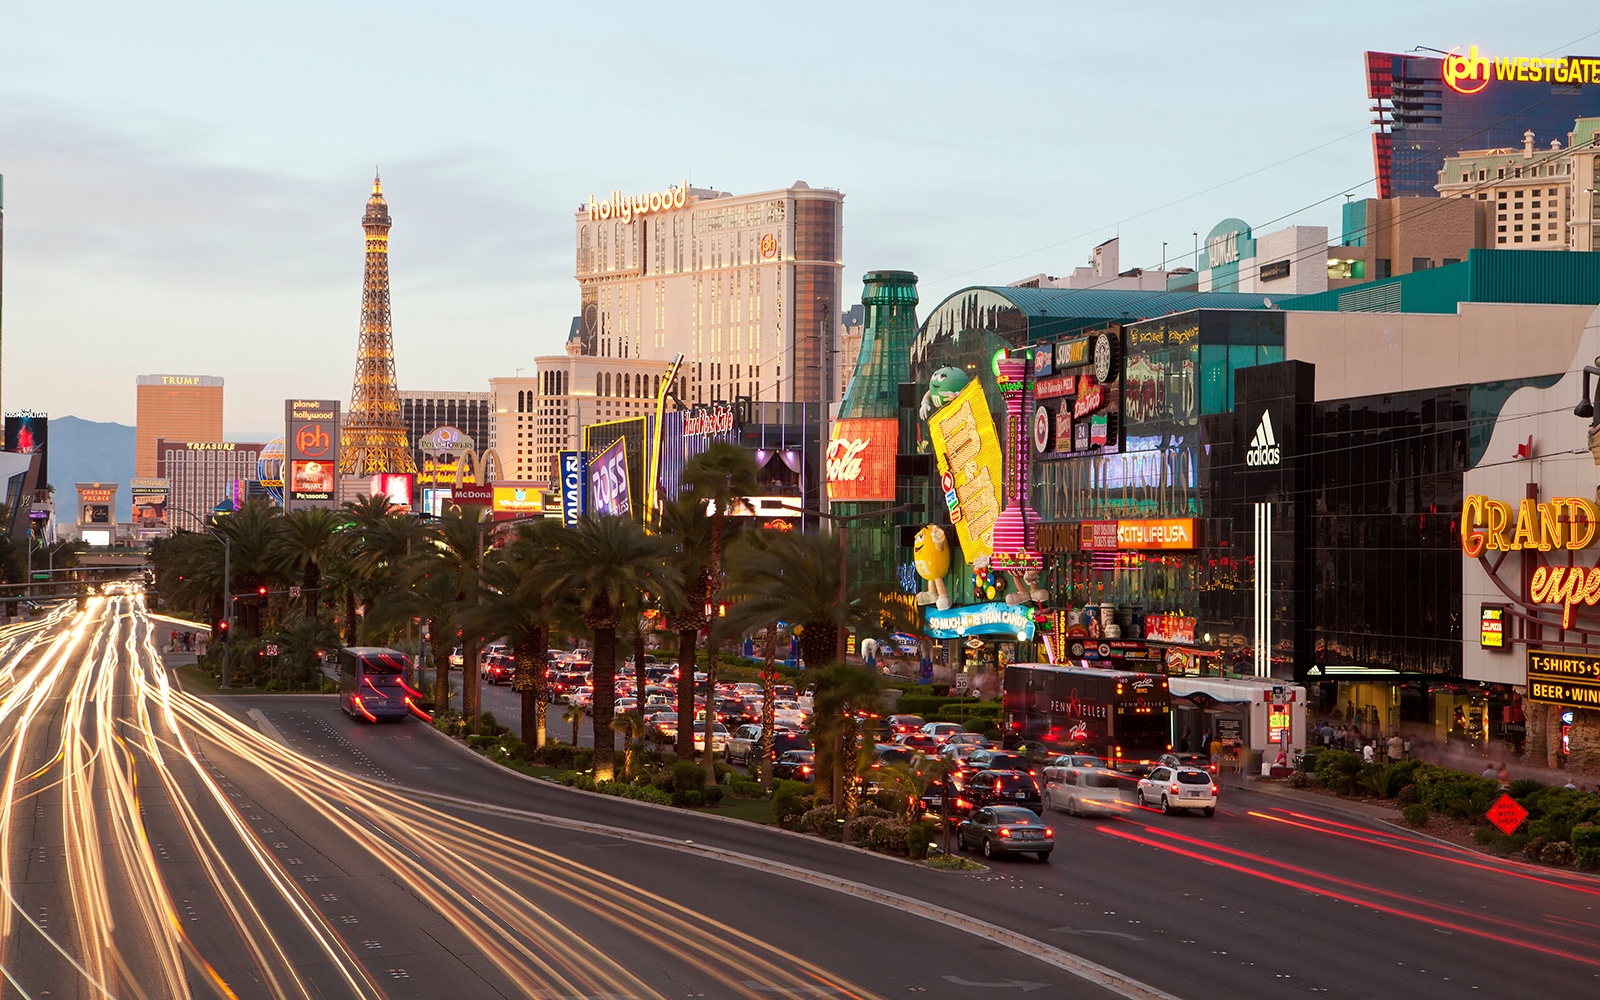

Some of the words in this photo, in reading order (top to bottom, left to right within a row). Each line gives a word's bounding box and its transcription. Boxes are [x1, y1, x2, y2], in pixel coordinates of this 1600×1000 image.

[1449, 45, 1489, 87] ph
[1494, 56, 1600, 84] WESTGATE
[589, 180, 687, 224] hollywood
[1056, 342, 1087, 366] SUBWAY
[162, 376, 200, 385] TRUMP
[294, 401, 320, 409] planet
[294, 411, 334, 420] hollywood
[683, 410, 702, 437] Hard
[702, 408, 717, 439] Rock
[717, 404, 733, 436] Cafe
[1078, 426, 1085, 438] 24
[187, 443, 236, 451] TREASURE
[1246, 446, 1280, 467] adidas
[592, 451, 627, 512] ROSS
[1042, 458, 1112, 519] WESTGATE
[1122, 451, 1188, 517] RESORTS
[455, 491, 491, 499] McDona
[764, 522, 779, 530] Hard
[778, 522, 793, 533] Rock
[1101, 524, 1116, 535] DISCOUNT
[1461, 494, 1600, 558] GRAND
[1094, 536, 1107, 547] TICKETS
[1531, 566, 1600, 630] expe
[930, 618, 939, 630] SO
[940, 616, 961, 631] MUCH
[961, 615, 981, 628] MORE
[982, 613, 1001, 625] THAN
[1002, 612, 1028, 628] CANDY
[1482, 610, 1503, 620] SUBWAY
[1532, 657, 1585, 674] T-SHIRTS
[1533, 683, 1564, 699] BEER
[1051, 701, 1072, 714] PENN
[1078, 704, 1107, 718] TELLER
